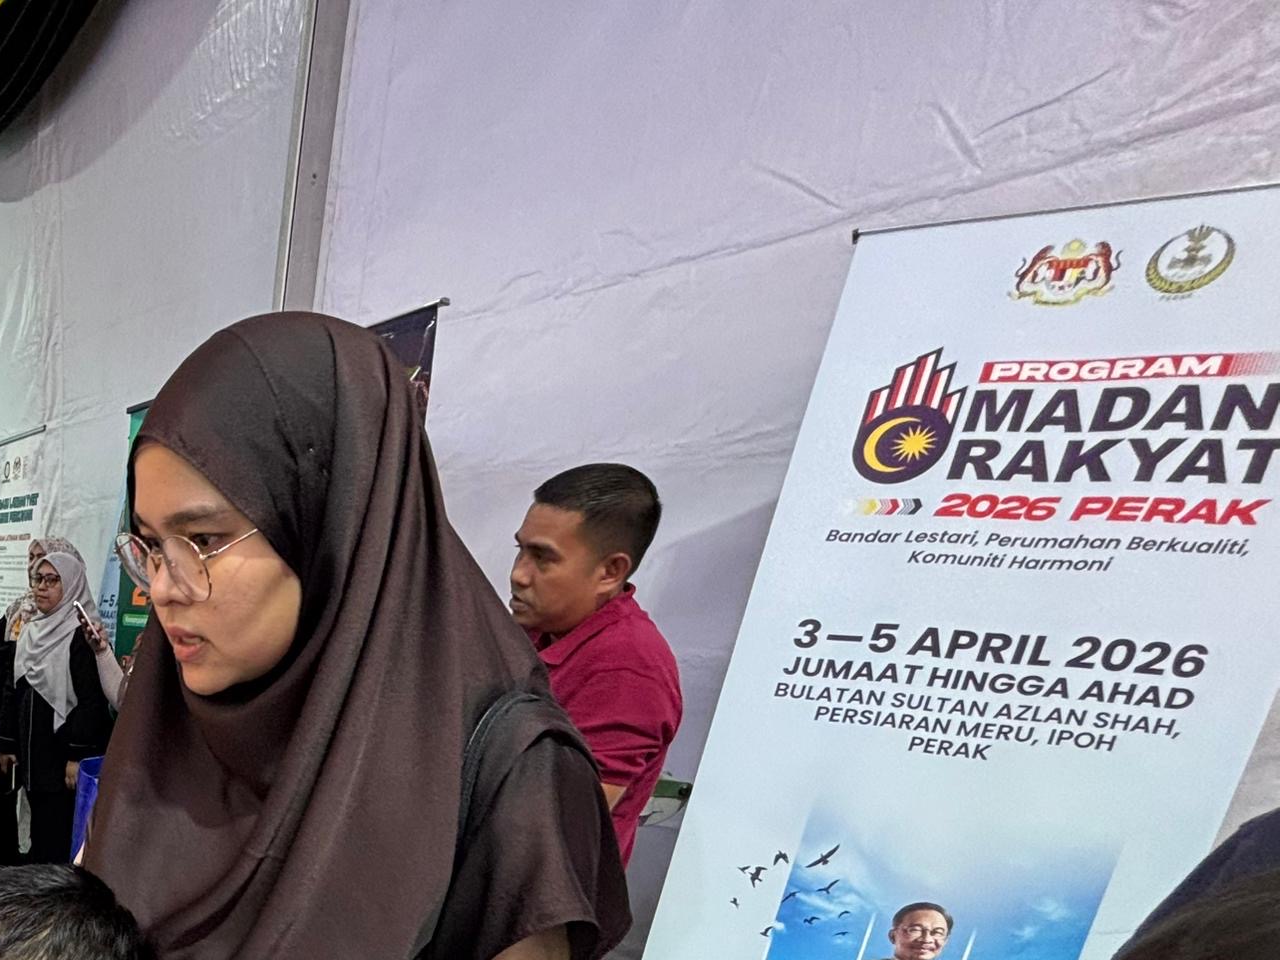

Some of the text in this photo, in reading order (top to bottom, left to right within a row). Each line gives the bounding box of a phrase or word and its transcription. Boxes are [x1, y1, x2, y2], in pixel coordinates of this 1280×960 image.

[990, 356, 1225, 383] PROGRAM
[946, 438, 1280, 484] RAKYAT
[933, 493, 1271, 526] 2026 PERAK
[825, 528, 1251, 559] Bandar Lestari, Perumahan Berkualiti,
[907, 550, 1113, 572] Komuniti Harmoni
[907, 628, 1053, 667] APRIL
[1065, 635, 1209, 679] 2026
[782, 656, 1195, 710] JUMAAT HINGGA AHAD
[774, 682, 1182, 740] BULATAN SULTAN AZLAN SHAH,
[814, 706, 1117, 752] PERSIARAN MERU, IPOH
[907, 736, 992, 761] PERAK
